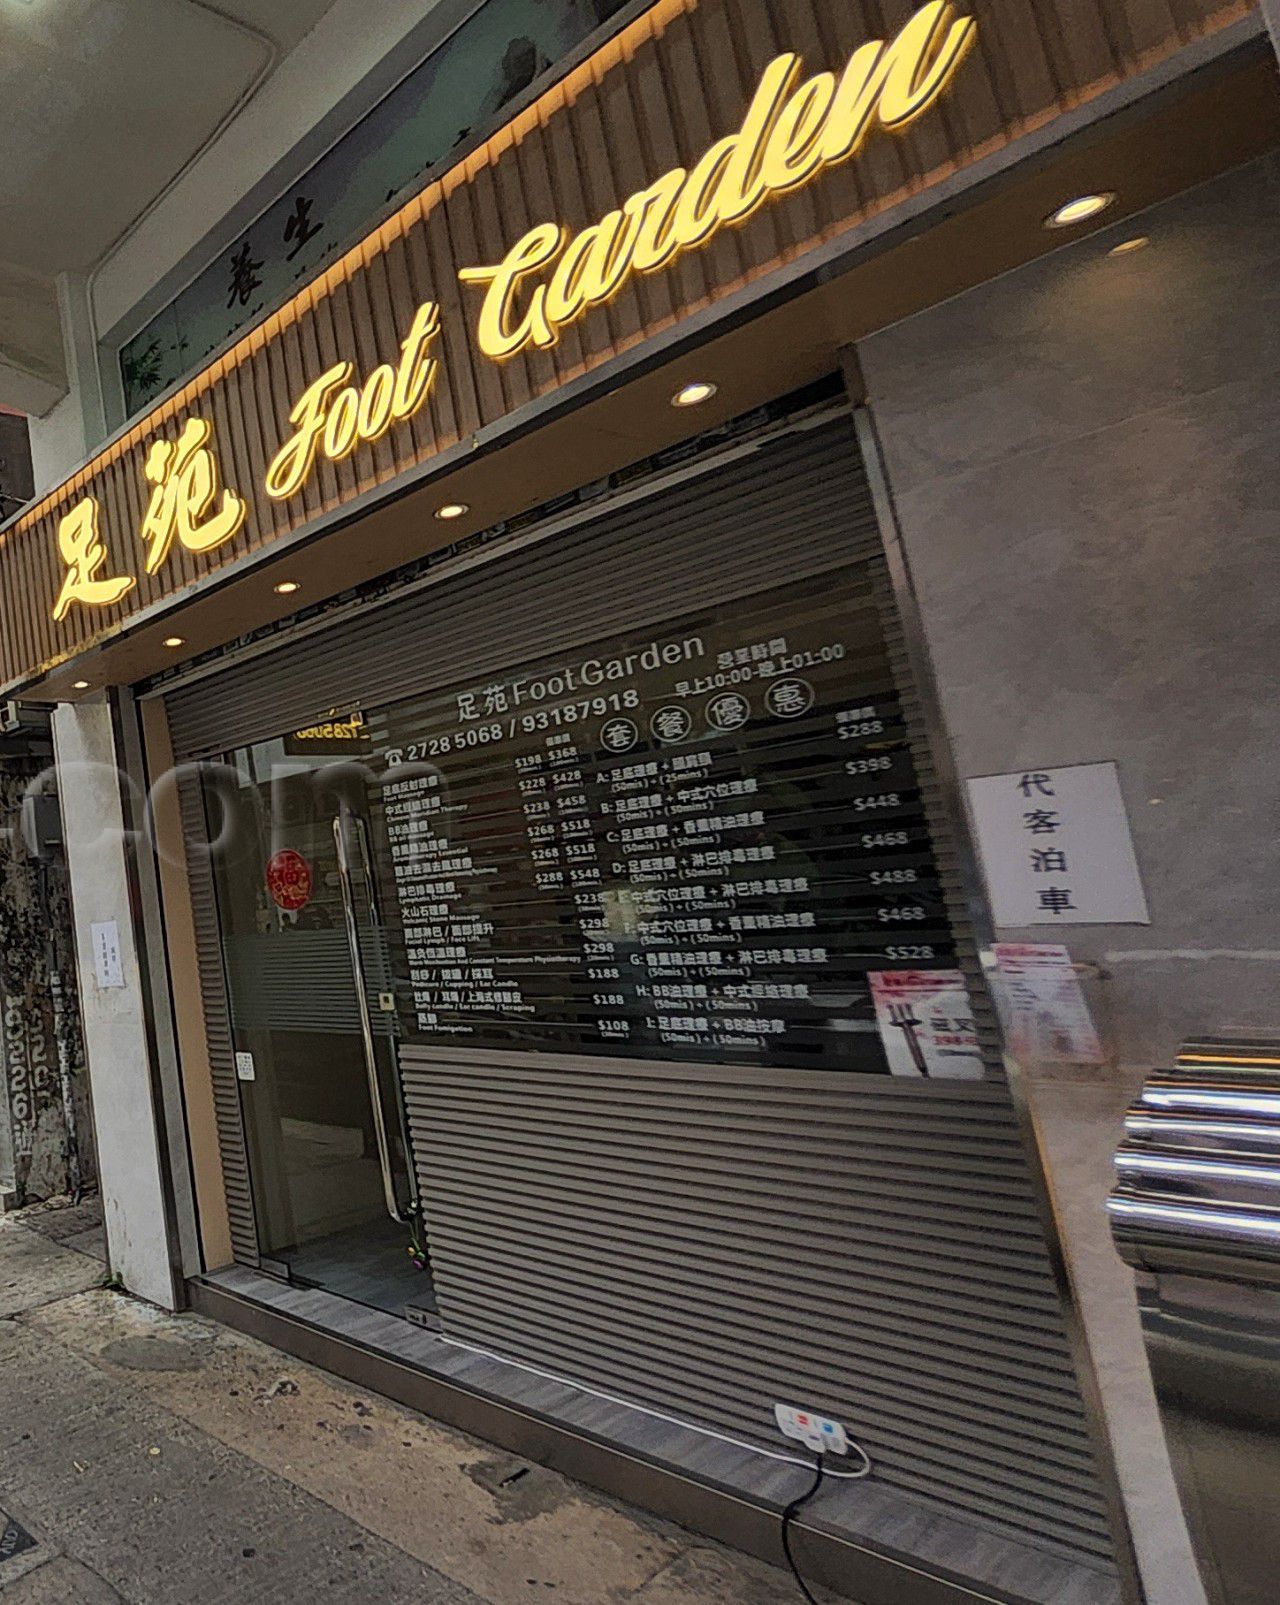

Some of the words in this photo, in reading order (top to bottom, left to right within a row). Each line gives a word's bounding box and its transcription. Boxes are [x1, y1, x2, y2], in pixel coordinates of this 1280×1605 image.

[52, 415, 248, 621] 足苑
[266, 299, 442, 500] Foot
[461, 0, 976, 360] Garden
[456, 682, 509, 723] 足苑
[511, 668, 577, 706] Foot
[581, 636, 705, 686] Garden
[407, 737, 451, 762] 2728
[455, 724, 504, 749] 5068
[522, 689, 640, 733] 93187918
[515, 754, 542, 768] $198
[548, 746, 577, 761] $368
[519, 777, 546, 791] $228
[552, 770, 582, 785] $428
[523, 801, 550, 815] $238
[557, 795, 587, 810] $458
[527, 824, 555, 838] $268
[561, 818, 591, 833] $518
[531, 847, 559, 861] $268
[565, 843, 595, 857] $518
[1016, 772, 1079, 916] 代客泊車
[535, 871, 564, 884] $288
[569, 868, 600, 882] $548
[583, 943, 615, 955] $298
[587, 968, 620, 980] $188
[592, 994, 625, 1006] $188
[597, 1020, 630, 1032] $108
